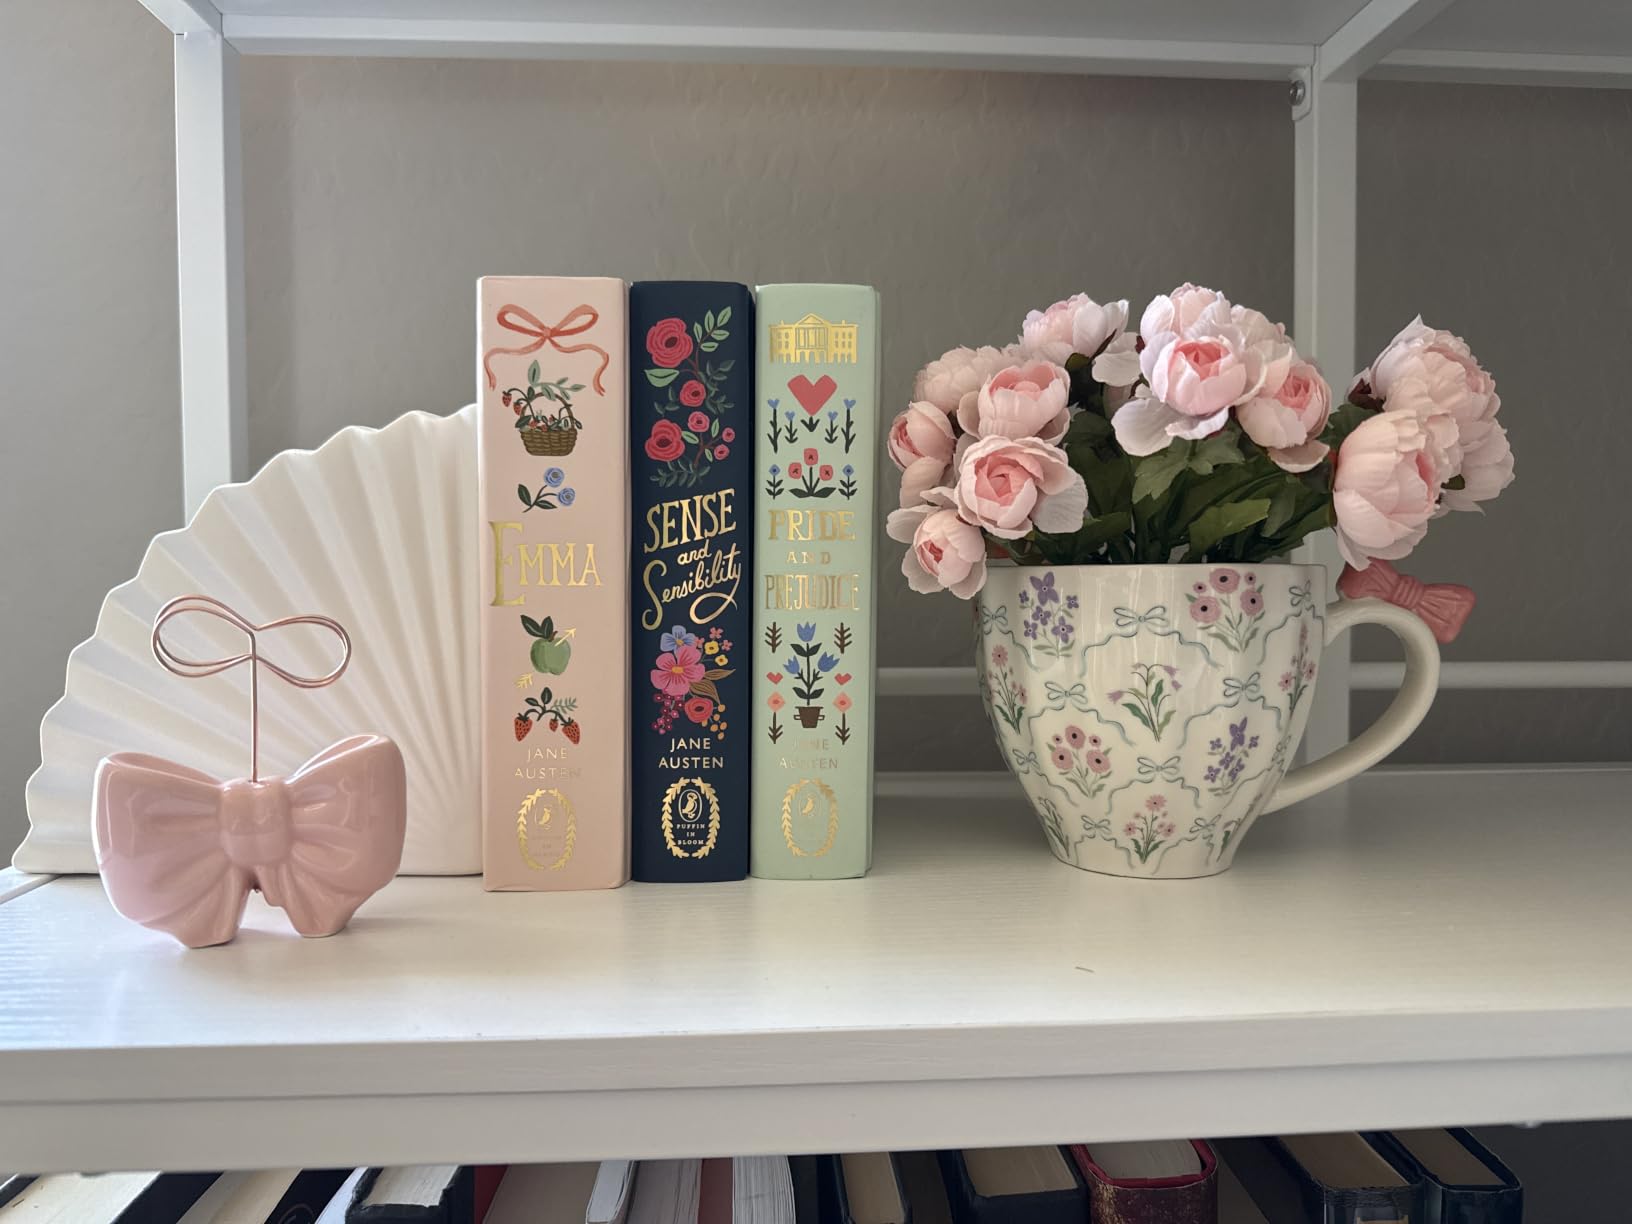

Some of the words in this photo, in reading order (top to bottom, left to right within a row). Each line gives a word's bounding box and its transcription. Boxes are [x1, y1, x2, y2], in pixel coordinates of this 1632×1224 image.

[644, 488, 737, 553] SENSE
[768, 509, 857, 541] PRIDE
[488, 521, 604, 607] EMMA
[677, 539, 712, 565] and
[786, 551, 832, 565] AND
[642, 542, 741, 630] Sensibility
[764, 574, 860, 611] PREJUDICE
[527, 747, 568, 762] JANE
[670, 738, 711, 752] JANE
[659, 757, 724, 769] AUSTEN
